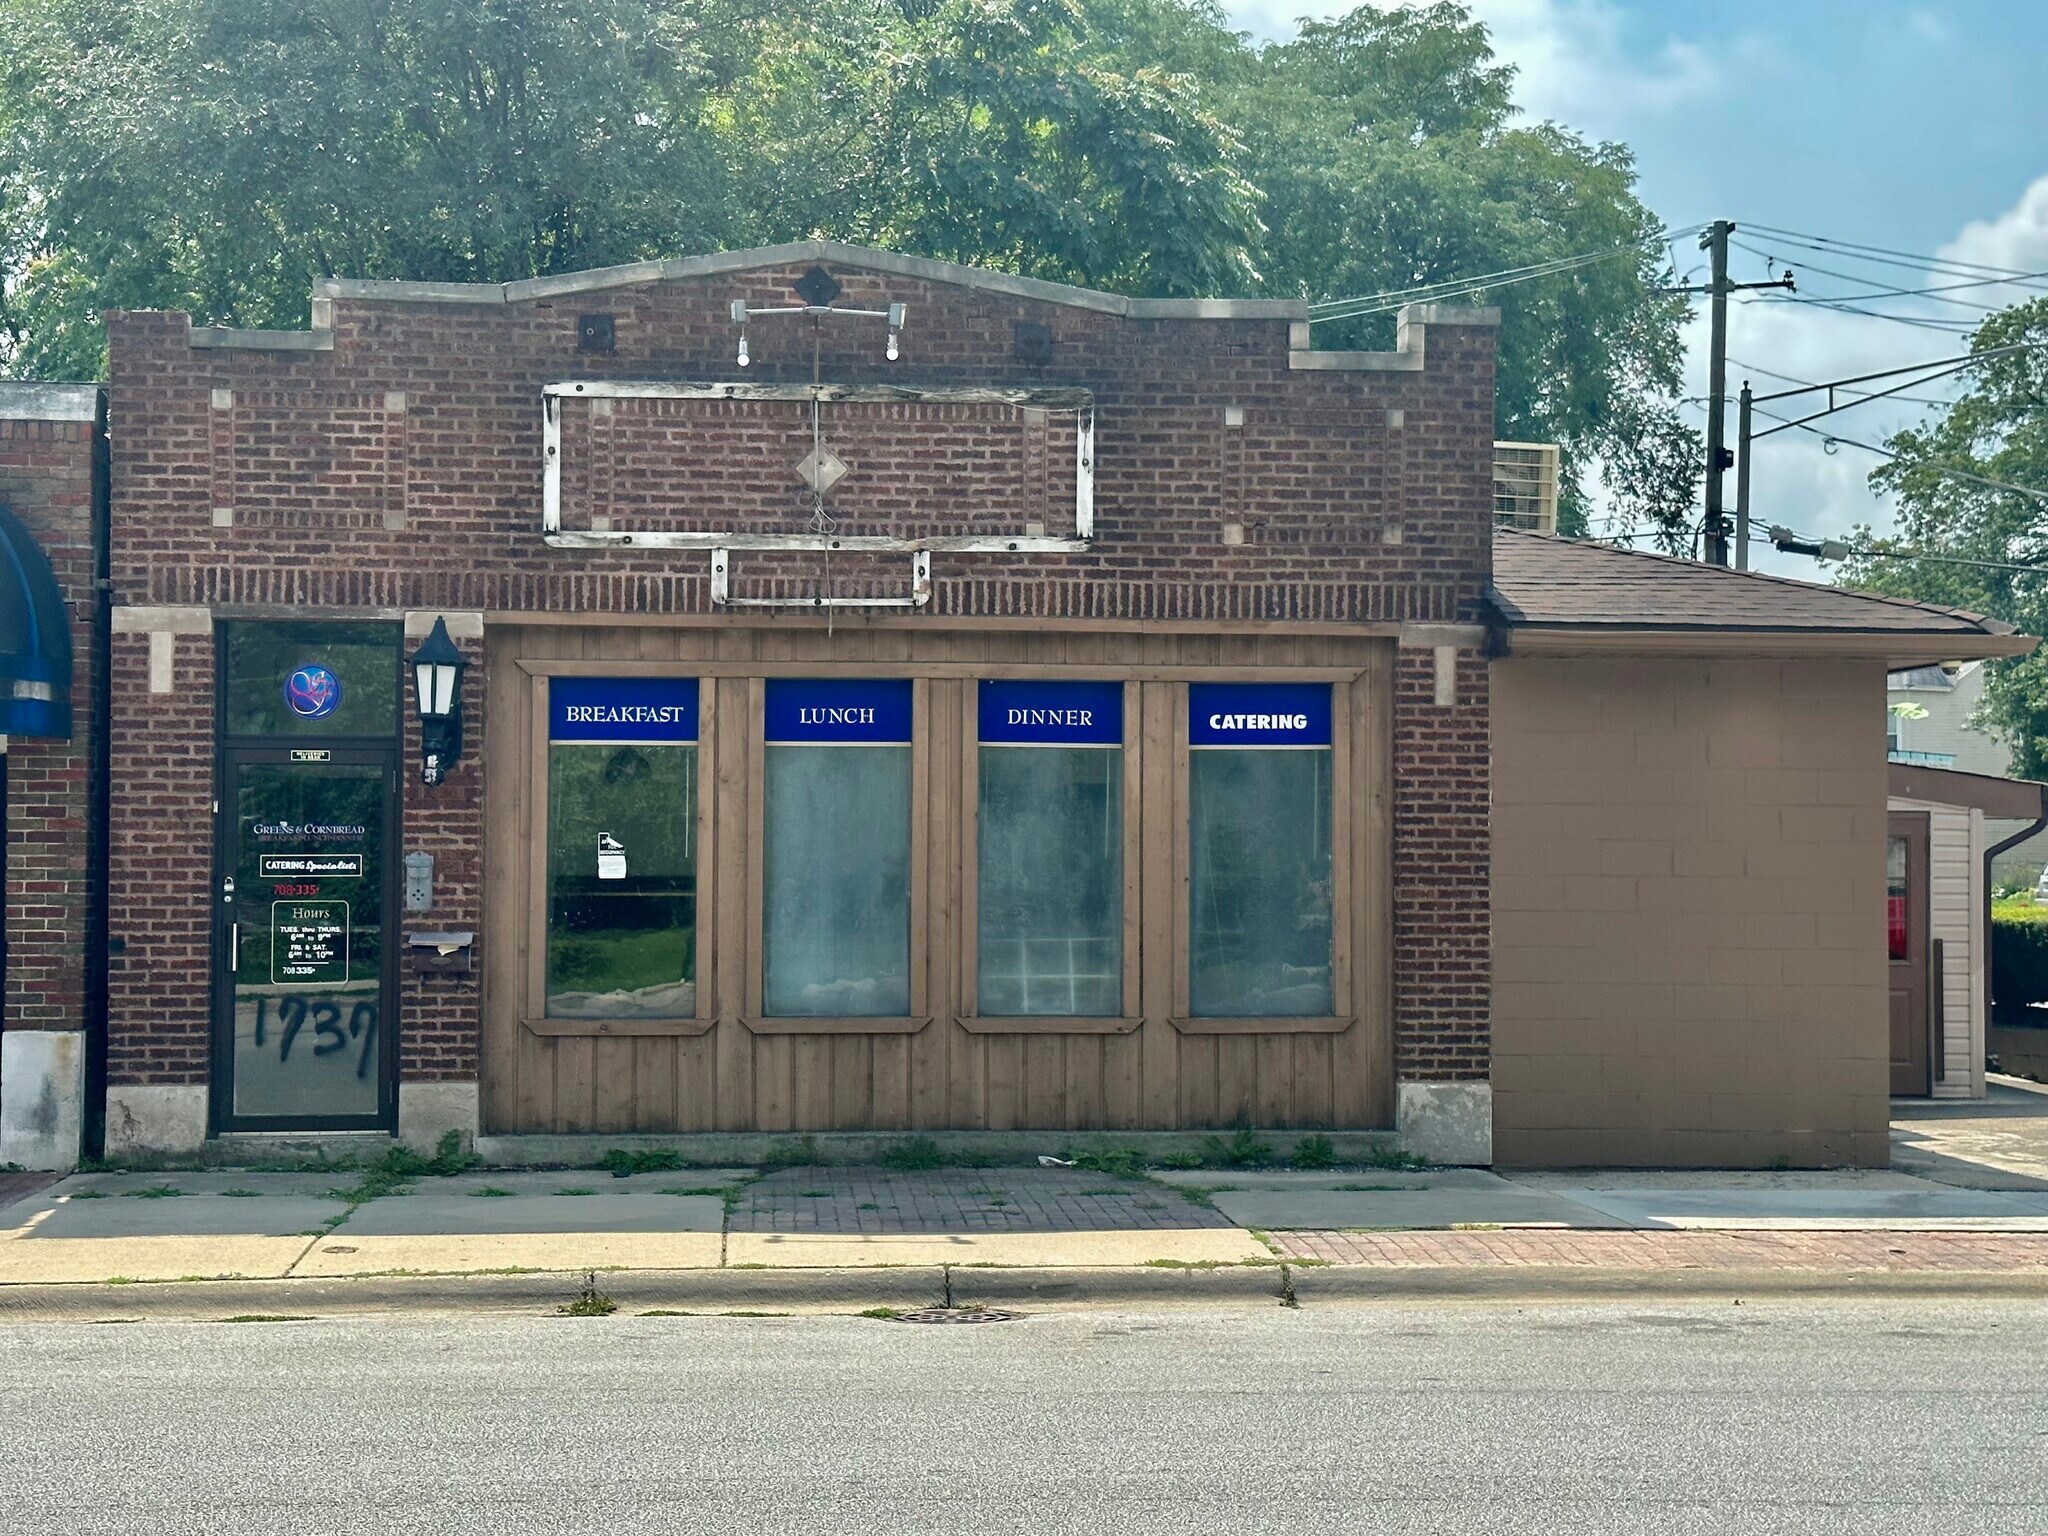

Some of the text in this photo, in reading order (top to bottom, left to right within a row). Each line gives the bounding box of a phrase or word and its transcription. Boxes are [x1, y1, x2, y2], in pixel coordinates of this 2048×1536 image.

[566, 705, 683, 723] BREAKFAST
[799, 707, 875, 724] LUNCH
[1008, 709, 1093, 727] DINNER
[1209, 714, 1308, 730] CATERING
[265, 860, 357, 873] CATERING Specialists
[292, 907, 330, 919] Hours
